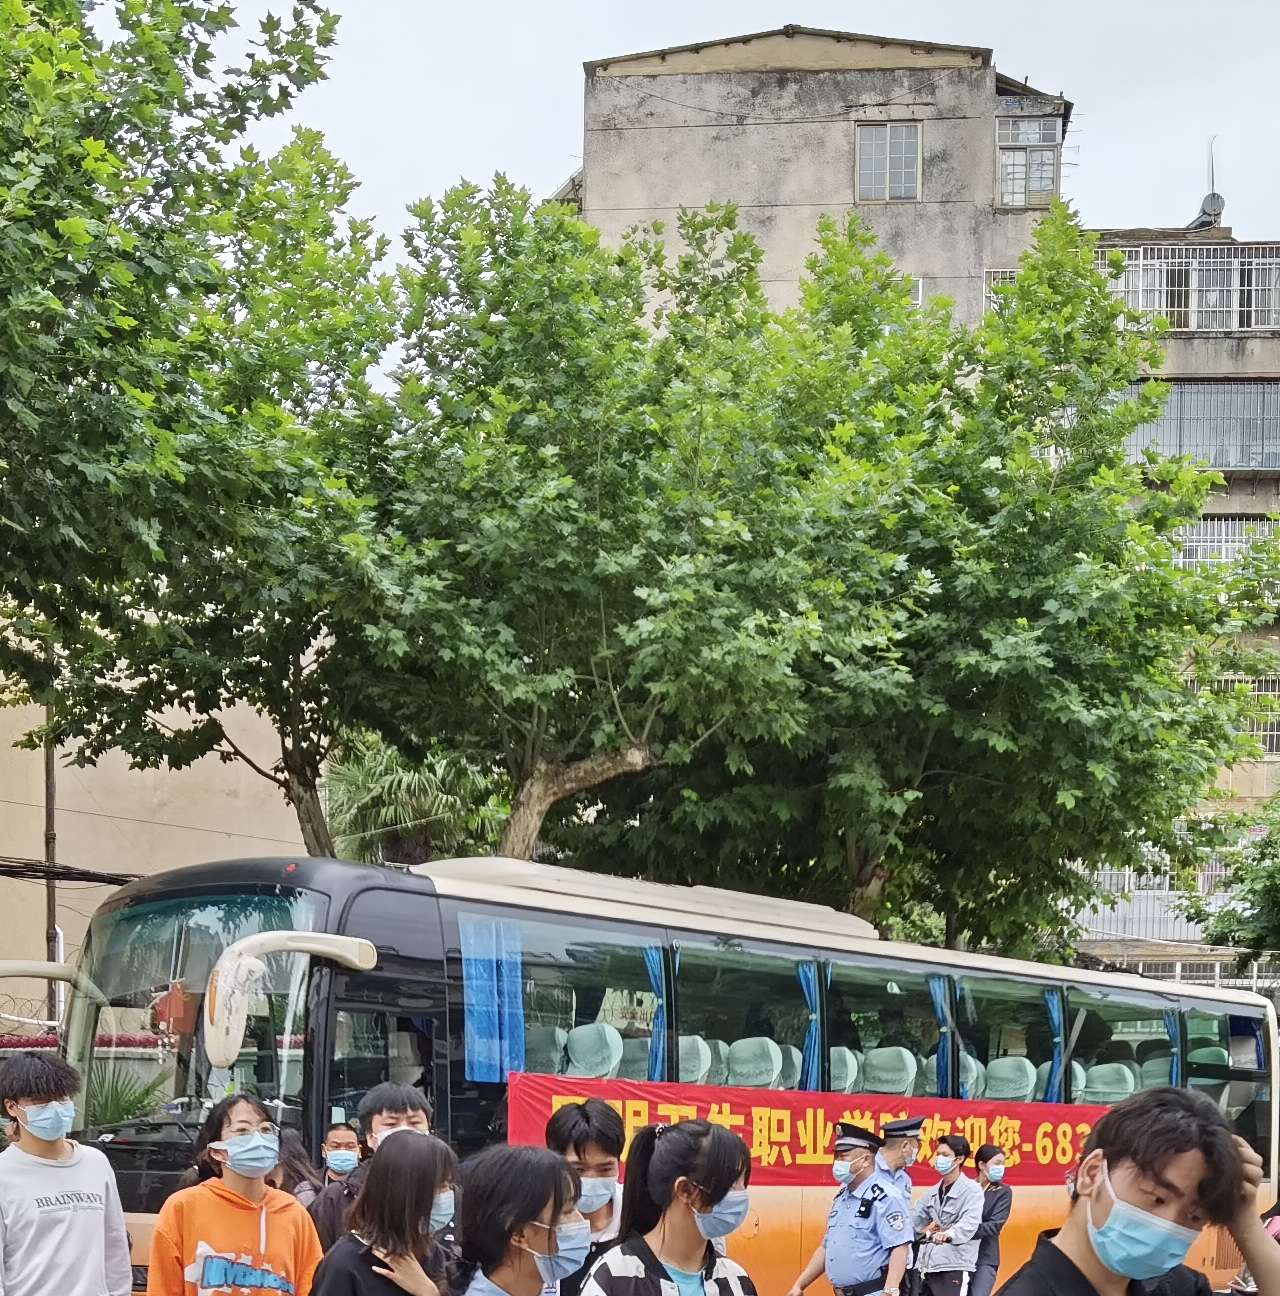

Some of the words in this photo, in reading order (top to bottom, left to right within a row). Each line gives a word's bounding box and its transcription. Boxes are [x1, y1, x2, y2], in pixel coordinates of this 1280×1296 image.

[552, 1095, 1091, 1168] 明生职业欢迎您-68
